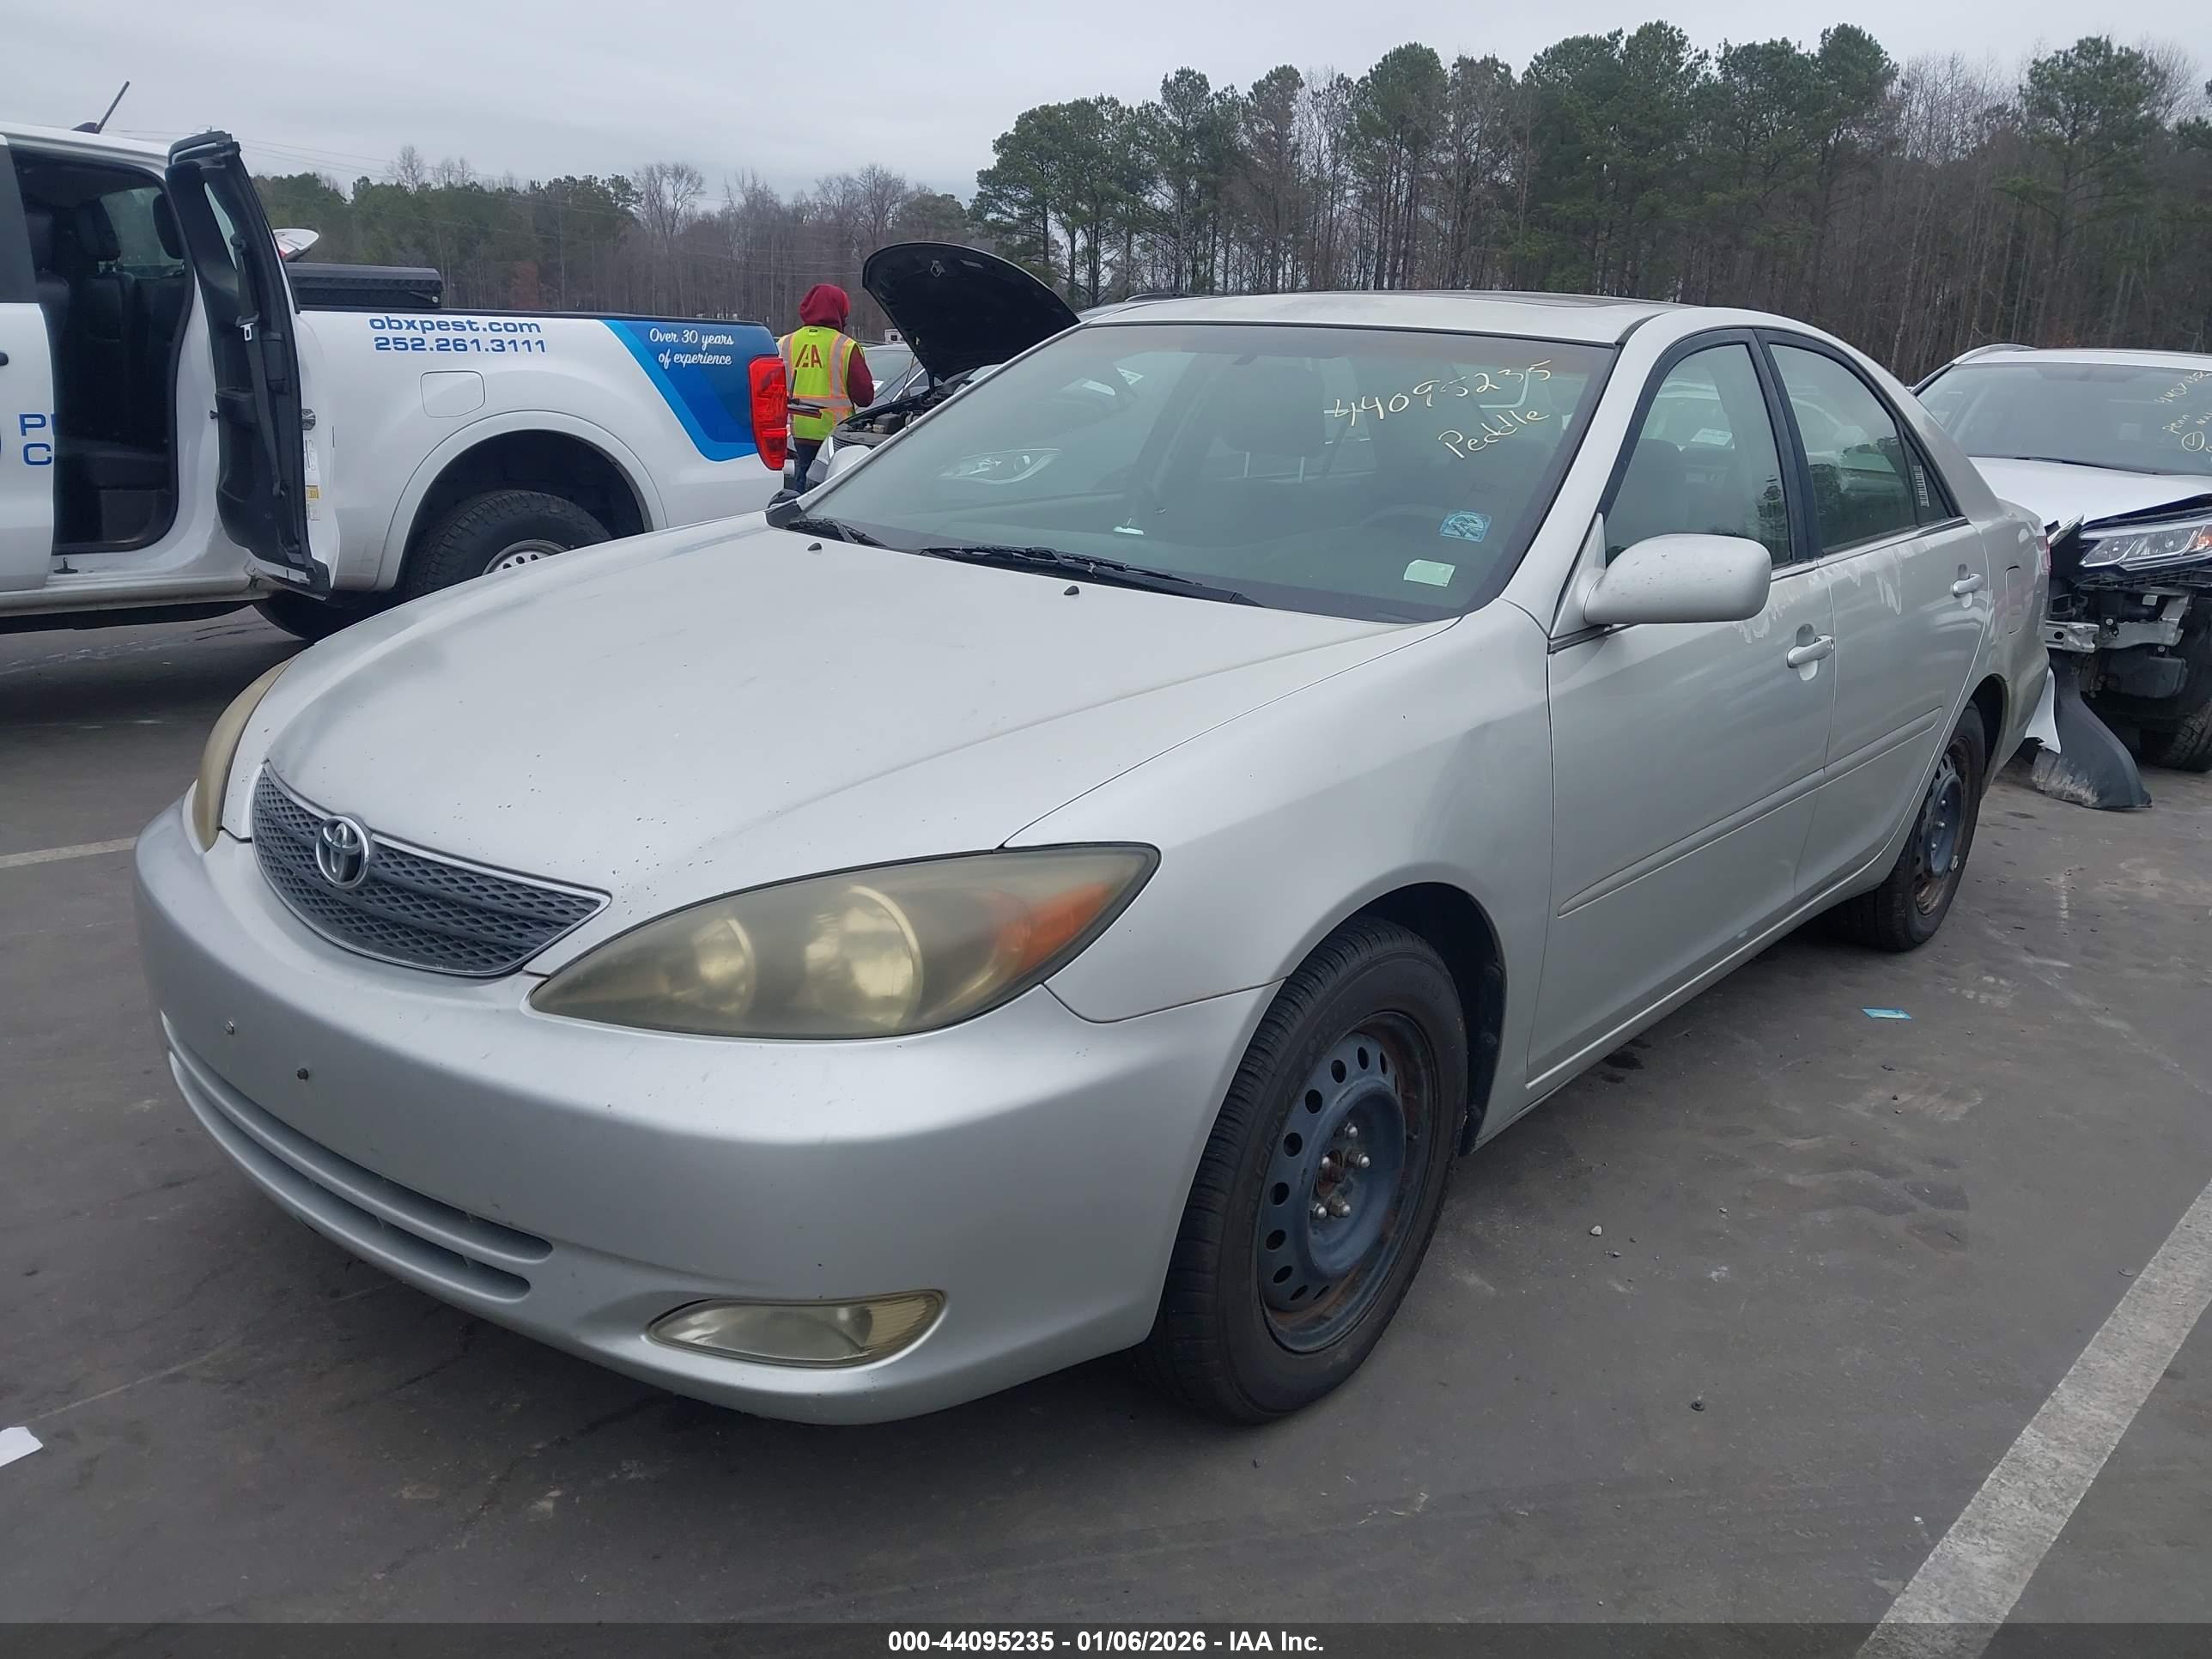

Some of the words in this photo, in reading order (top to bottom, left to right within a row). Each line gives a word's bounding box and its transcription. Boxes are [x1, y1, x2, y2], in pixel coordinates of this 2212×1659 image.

[368, 316, 542, 334] obxpest.com
[374, 336, 546, 353] 252.261.3111
[649, 327, 679, 343] Over
[681, 329, 698, 343] 30
[701, 333, 734, 350] years
[658, 348, 672, 369] of
[673, 351, 732, 368] experience
[1334, 359, 1552, 427] 44095235
[19, 413, 56, 436] P
[1437, 410, 1551, 459] Peddle
